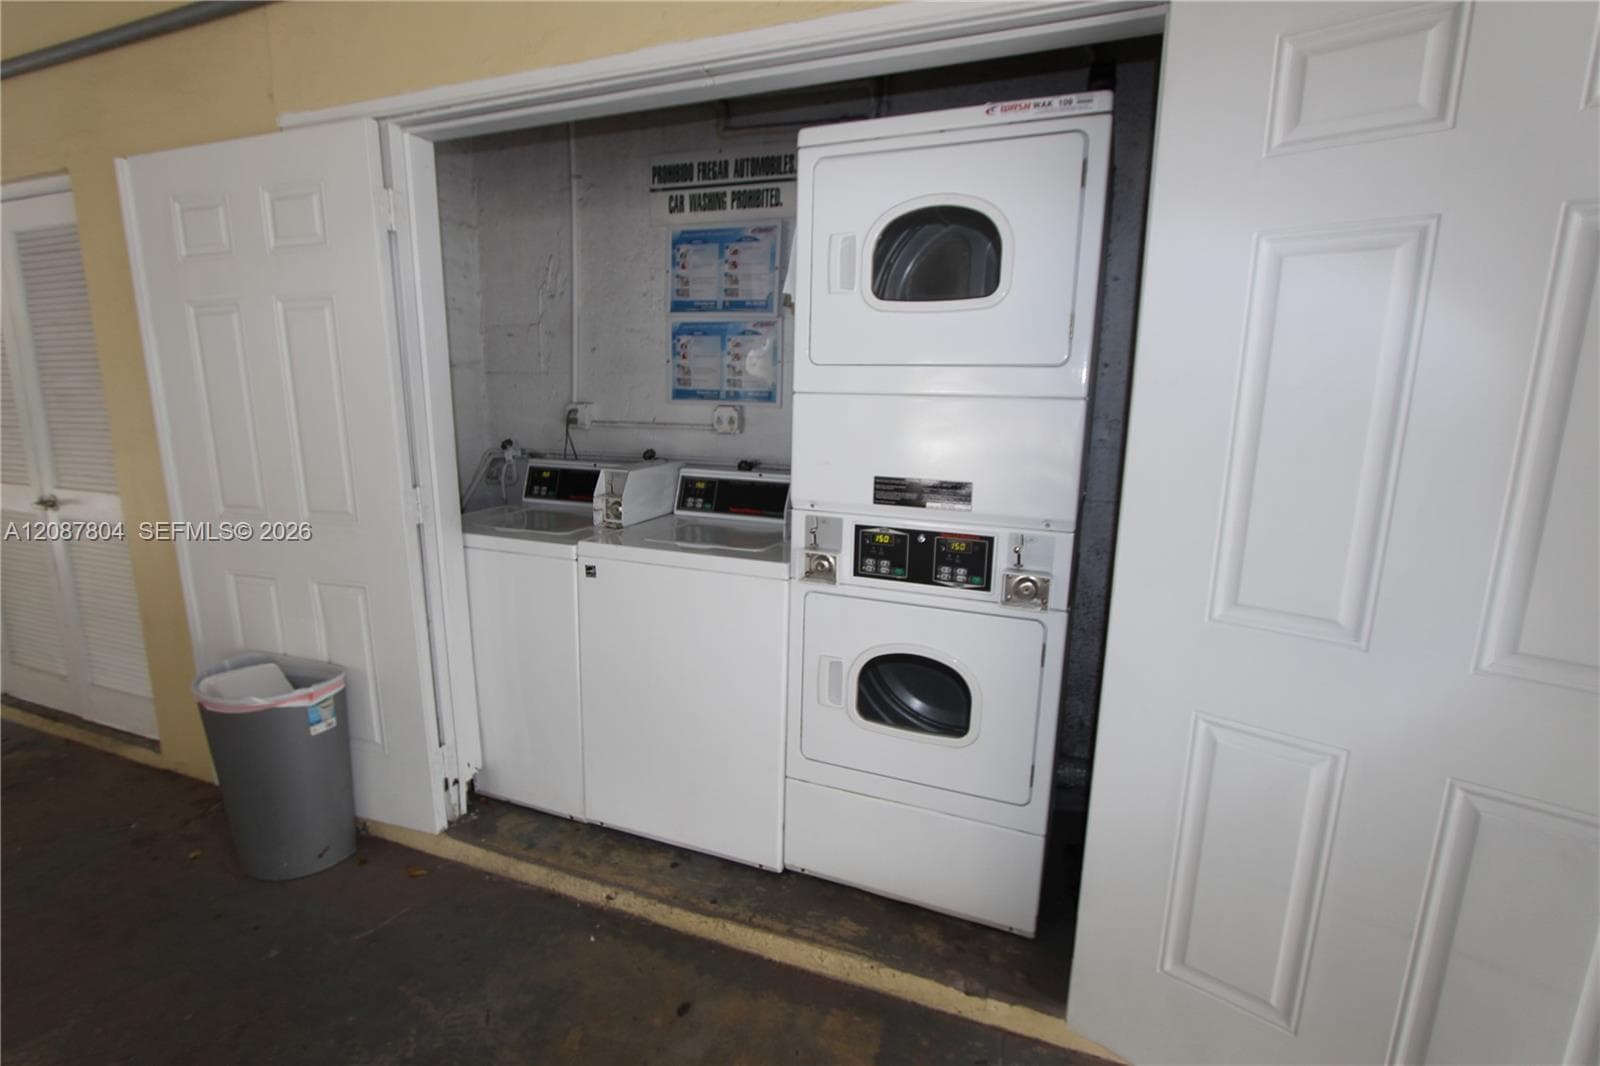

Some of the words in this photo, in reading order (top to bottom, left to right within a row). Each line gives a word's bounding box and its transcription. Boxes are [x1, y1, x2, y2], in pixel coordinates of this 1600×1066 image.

[652, 163, 694, 184] PROHIBIDO
[697, 160, 729, 181] FREGAR
[668, 194, 685, 214] CAR
[689, 191, 727, 212] WASHING
[731, 187, 783, 210] PROHIBITED.
